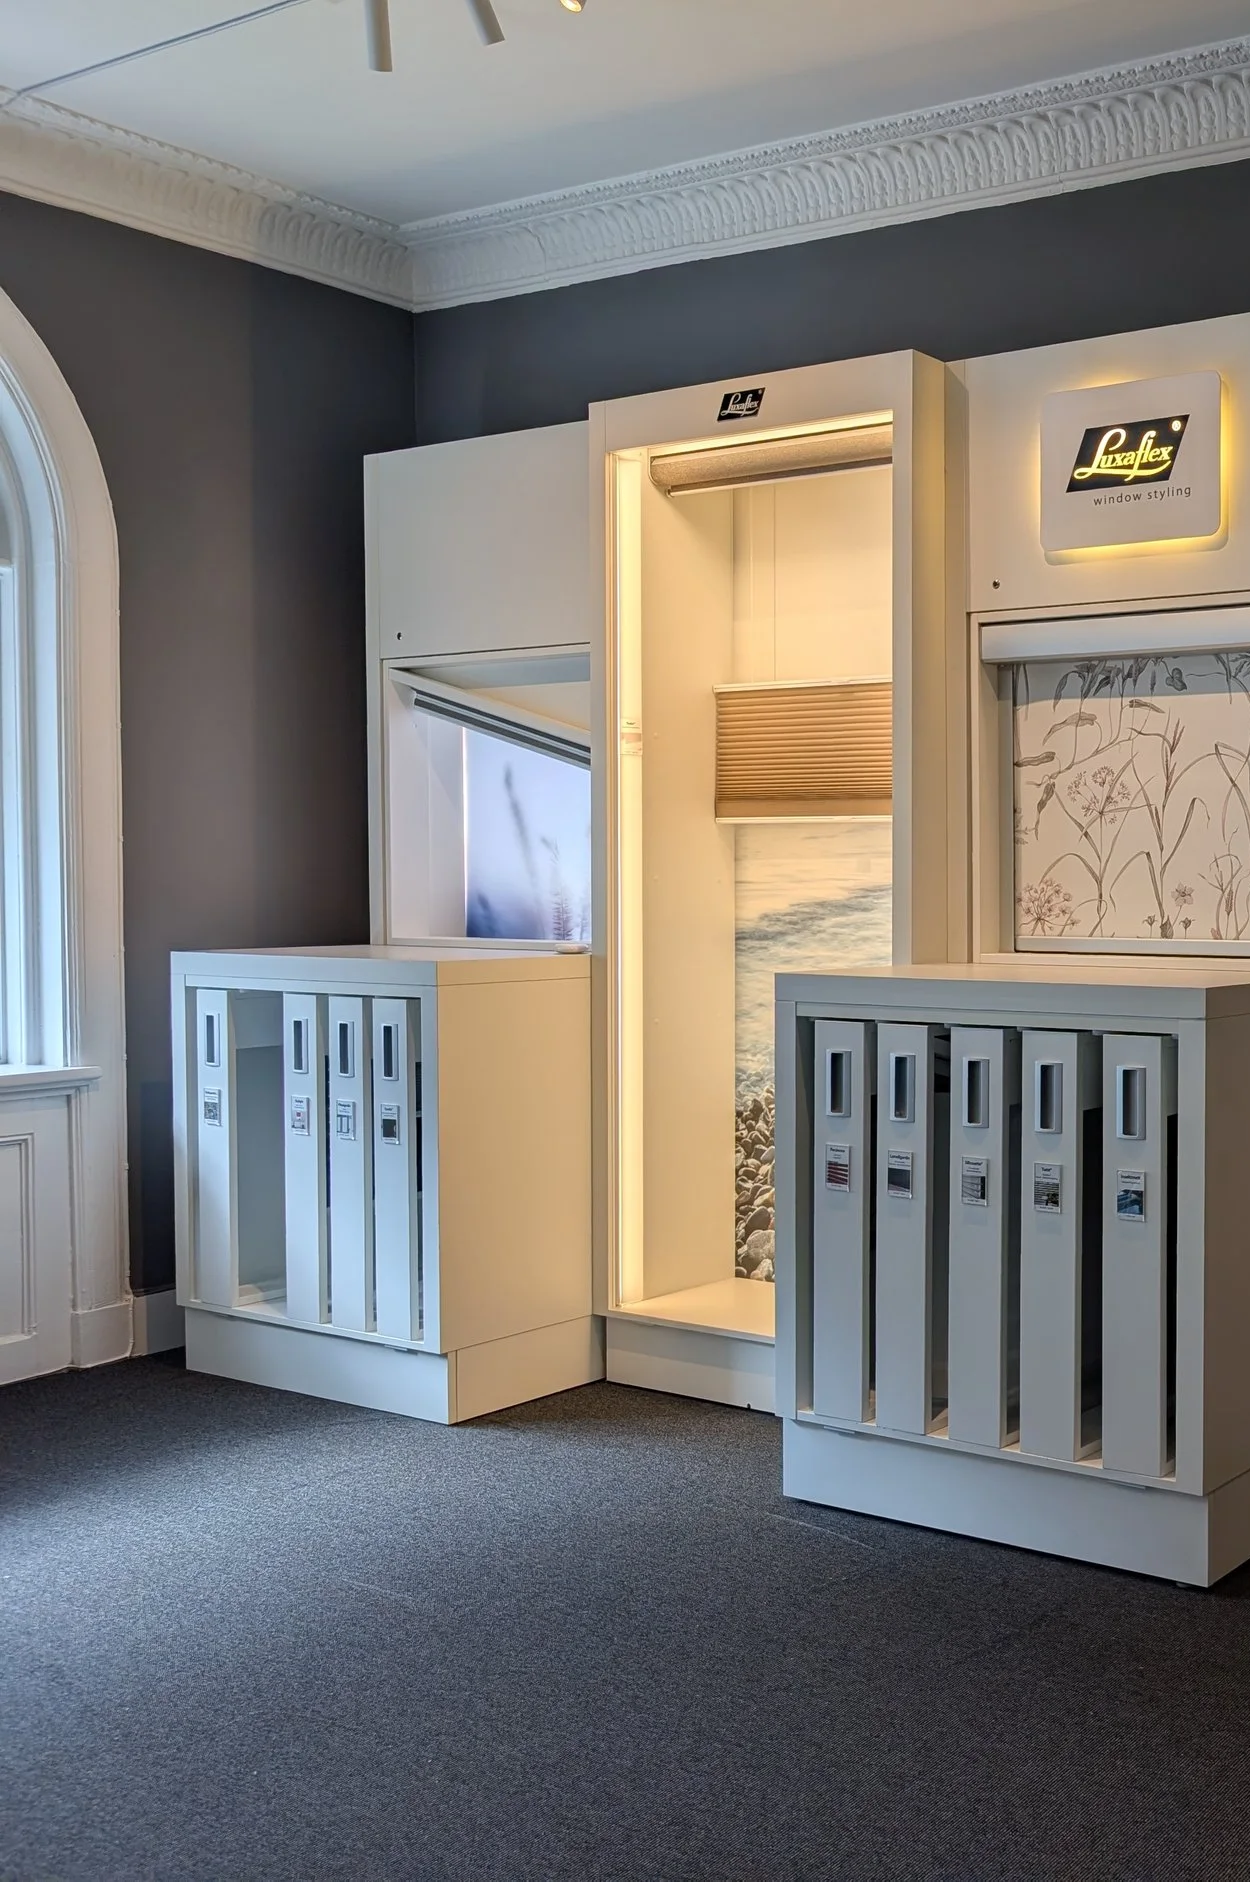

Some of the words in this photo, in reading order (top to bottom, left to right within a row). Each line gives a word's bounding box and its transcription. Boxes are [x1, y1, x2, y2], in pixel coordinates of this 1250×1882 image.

[720, 392, 760, 417] Luxaflex
[1073, 428, 1174, 482] Luxaflex
[1093, 492, 1142, 506] window
[1147, 486, 1191, 501] styling
